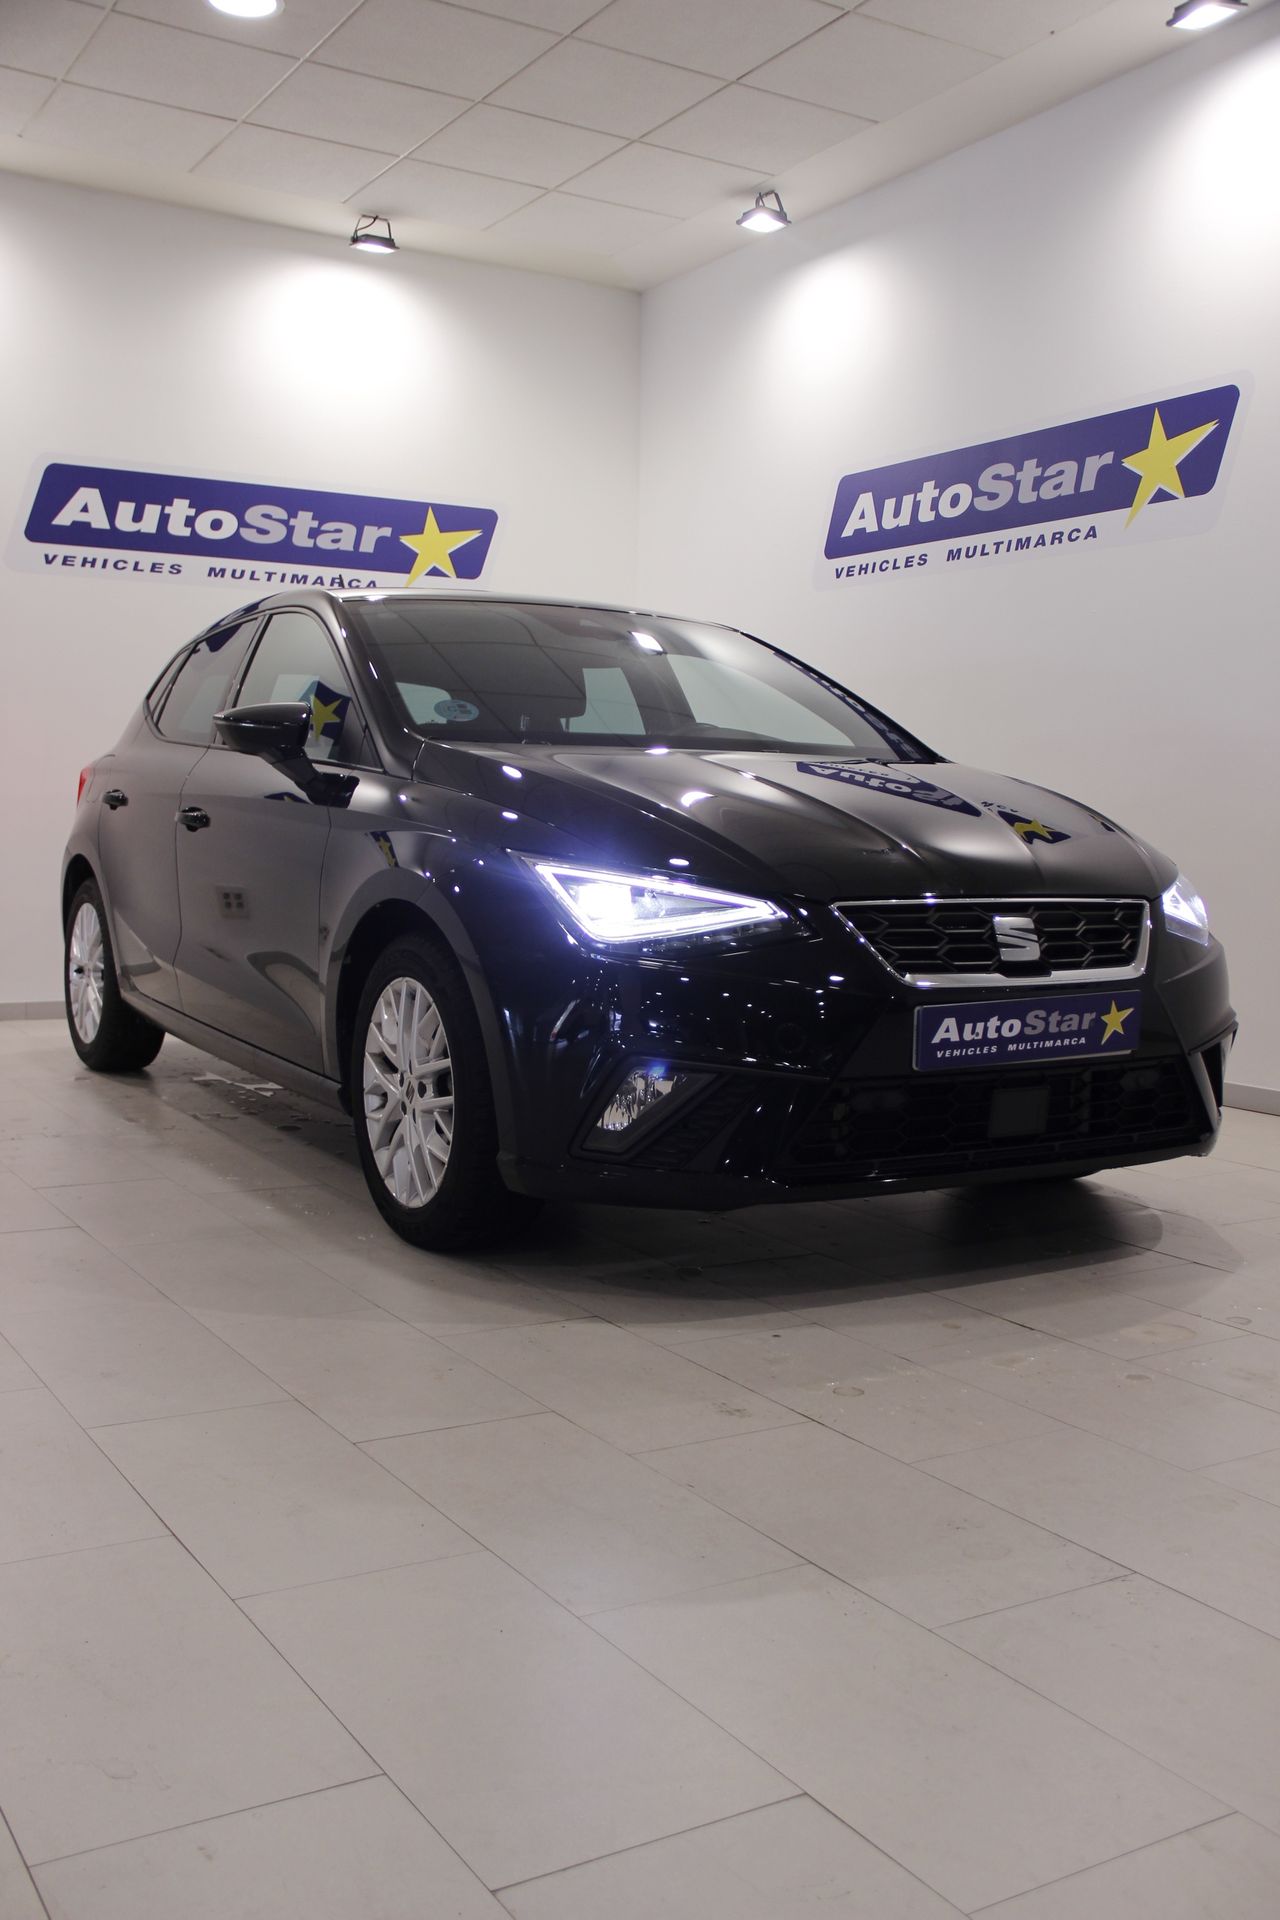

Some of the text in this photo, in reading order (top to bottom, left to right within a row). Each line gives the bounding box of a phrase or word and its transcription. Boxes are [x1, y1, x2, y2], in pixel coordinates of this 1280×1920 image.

[841, 451, 1114, 538] AutoStar
[51, 486, 392, 553] AutoStar
[43, 554, 378, 588] VEHICLES MULTIMARCA
[835, 525, 1098, 579] VEHICLES MULTIMARCA
[931, 1009, 1096, 1044] AutoStar
[936, 1037, 1087, 1058] VEHICLES MULTIMARCA
